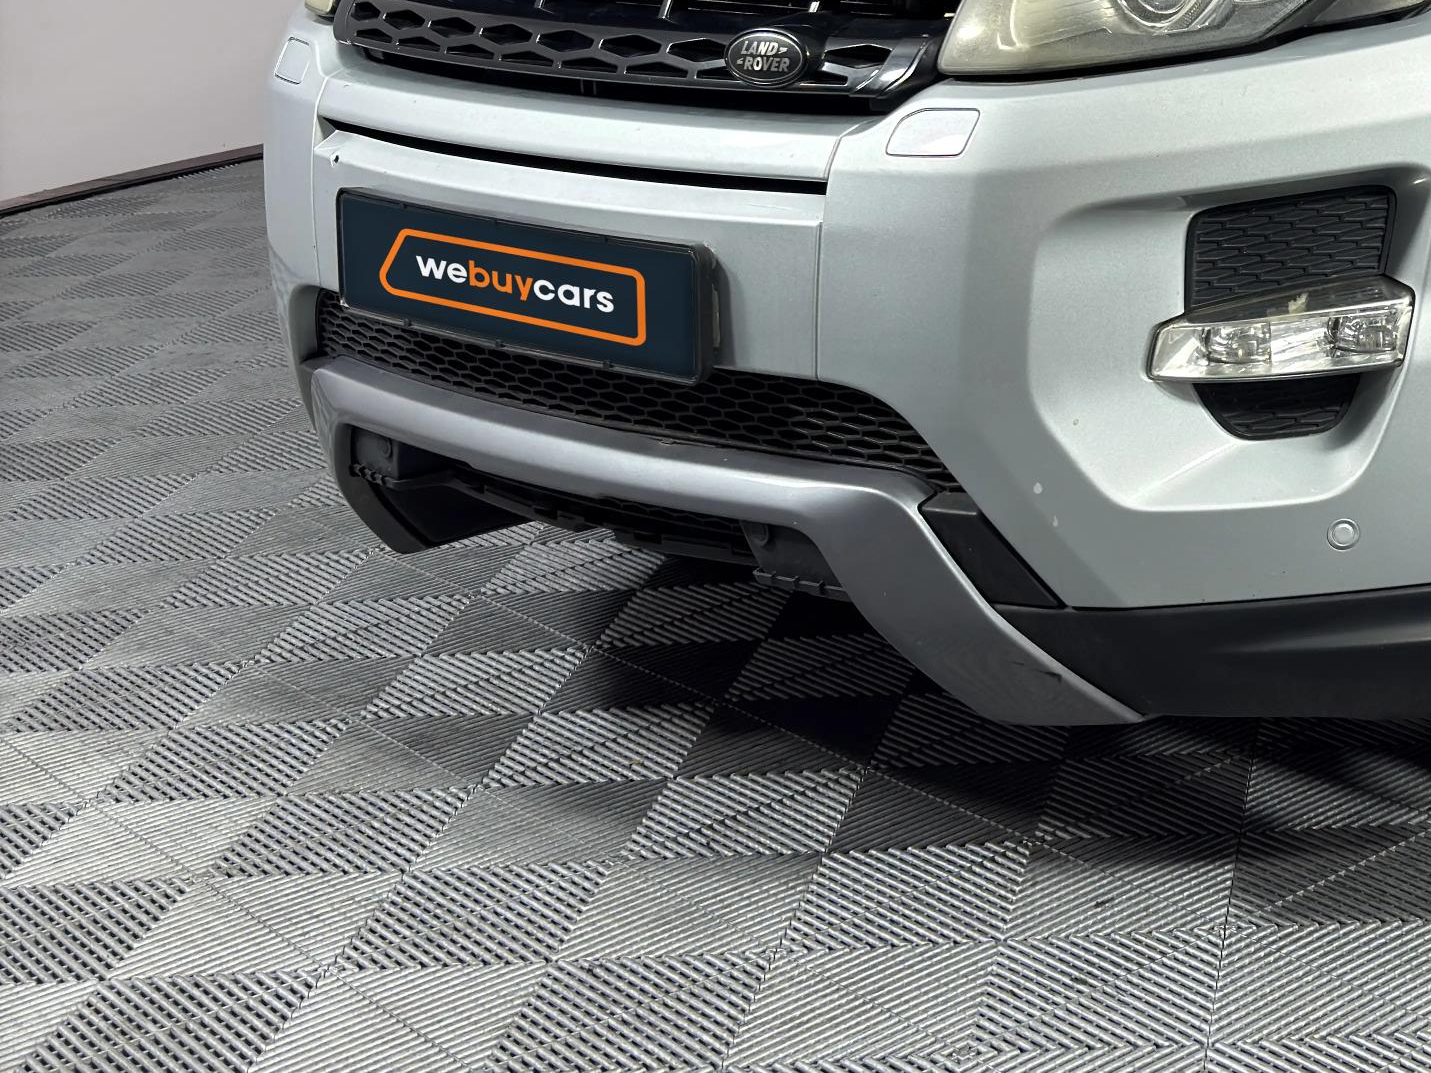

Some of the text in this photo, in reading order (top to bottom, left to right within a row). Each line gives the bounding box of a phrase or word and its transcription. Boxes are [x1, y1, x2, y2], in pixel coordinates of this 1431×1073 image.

[740, 40, 779, 56] LAND
[743, 56, 791, 72] ROVER
[415, 254, 615, 313] webuycars
